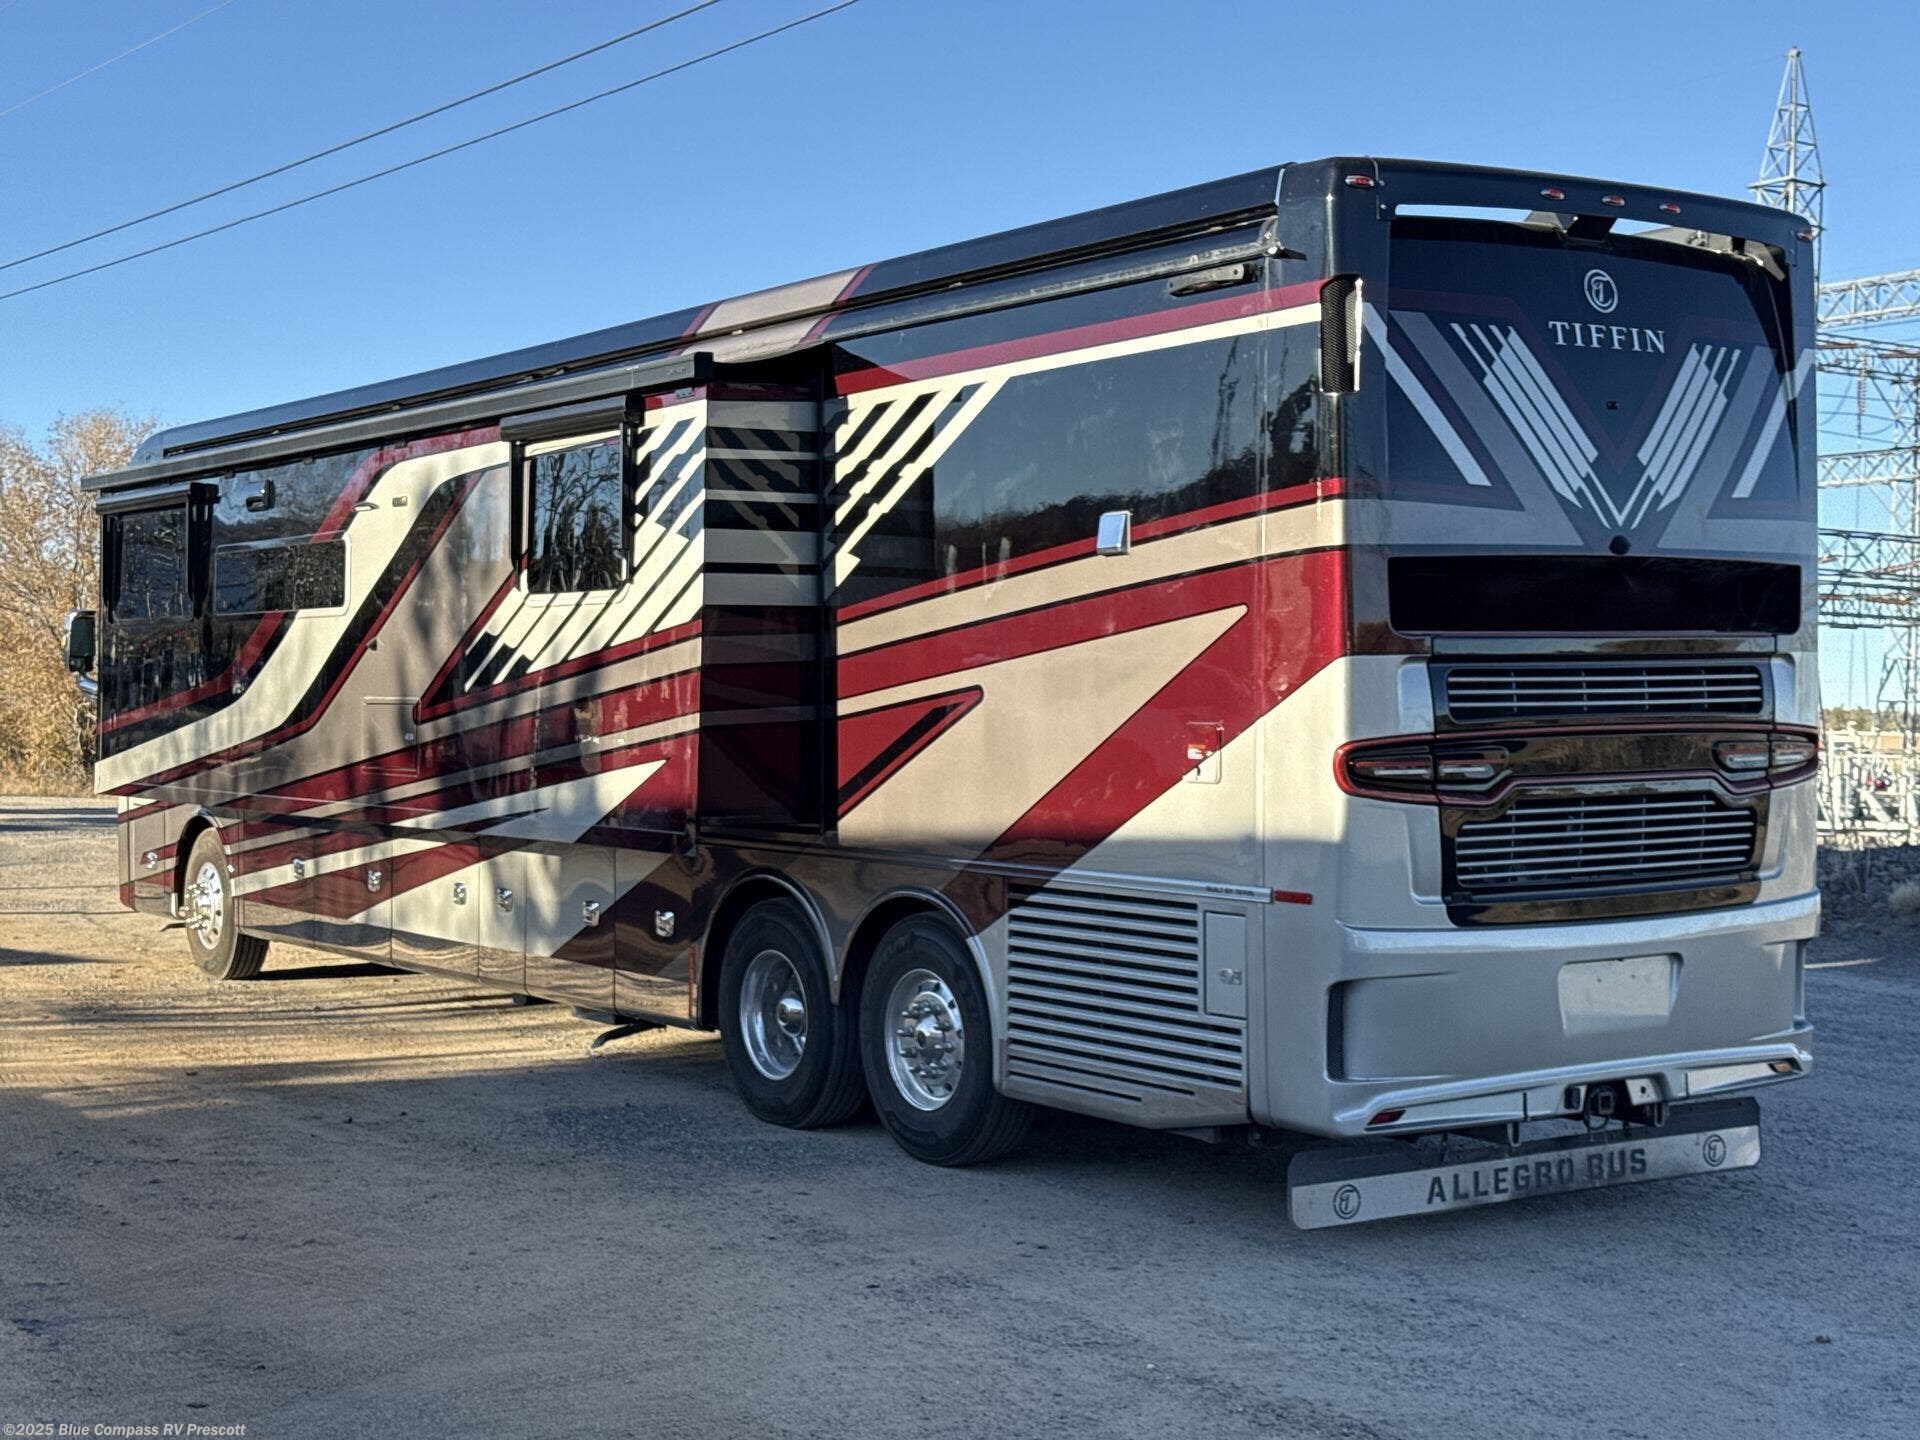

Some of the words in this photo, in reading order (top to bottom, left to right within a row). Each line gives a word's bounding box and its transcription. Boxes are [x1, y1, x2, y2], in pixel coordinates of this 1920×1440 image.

[1549, 321, 1665, 353] TIFFIN
[1427, 1158, 1575, 1204] ALLEGRO
[1587, 1148, 1646, 1180] BUS
